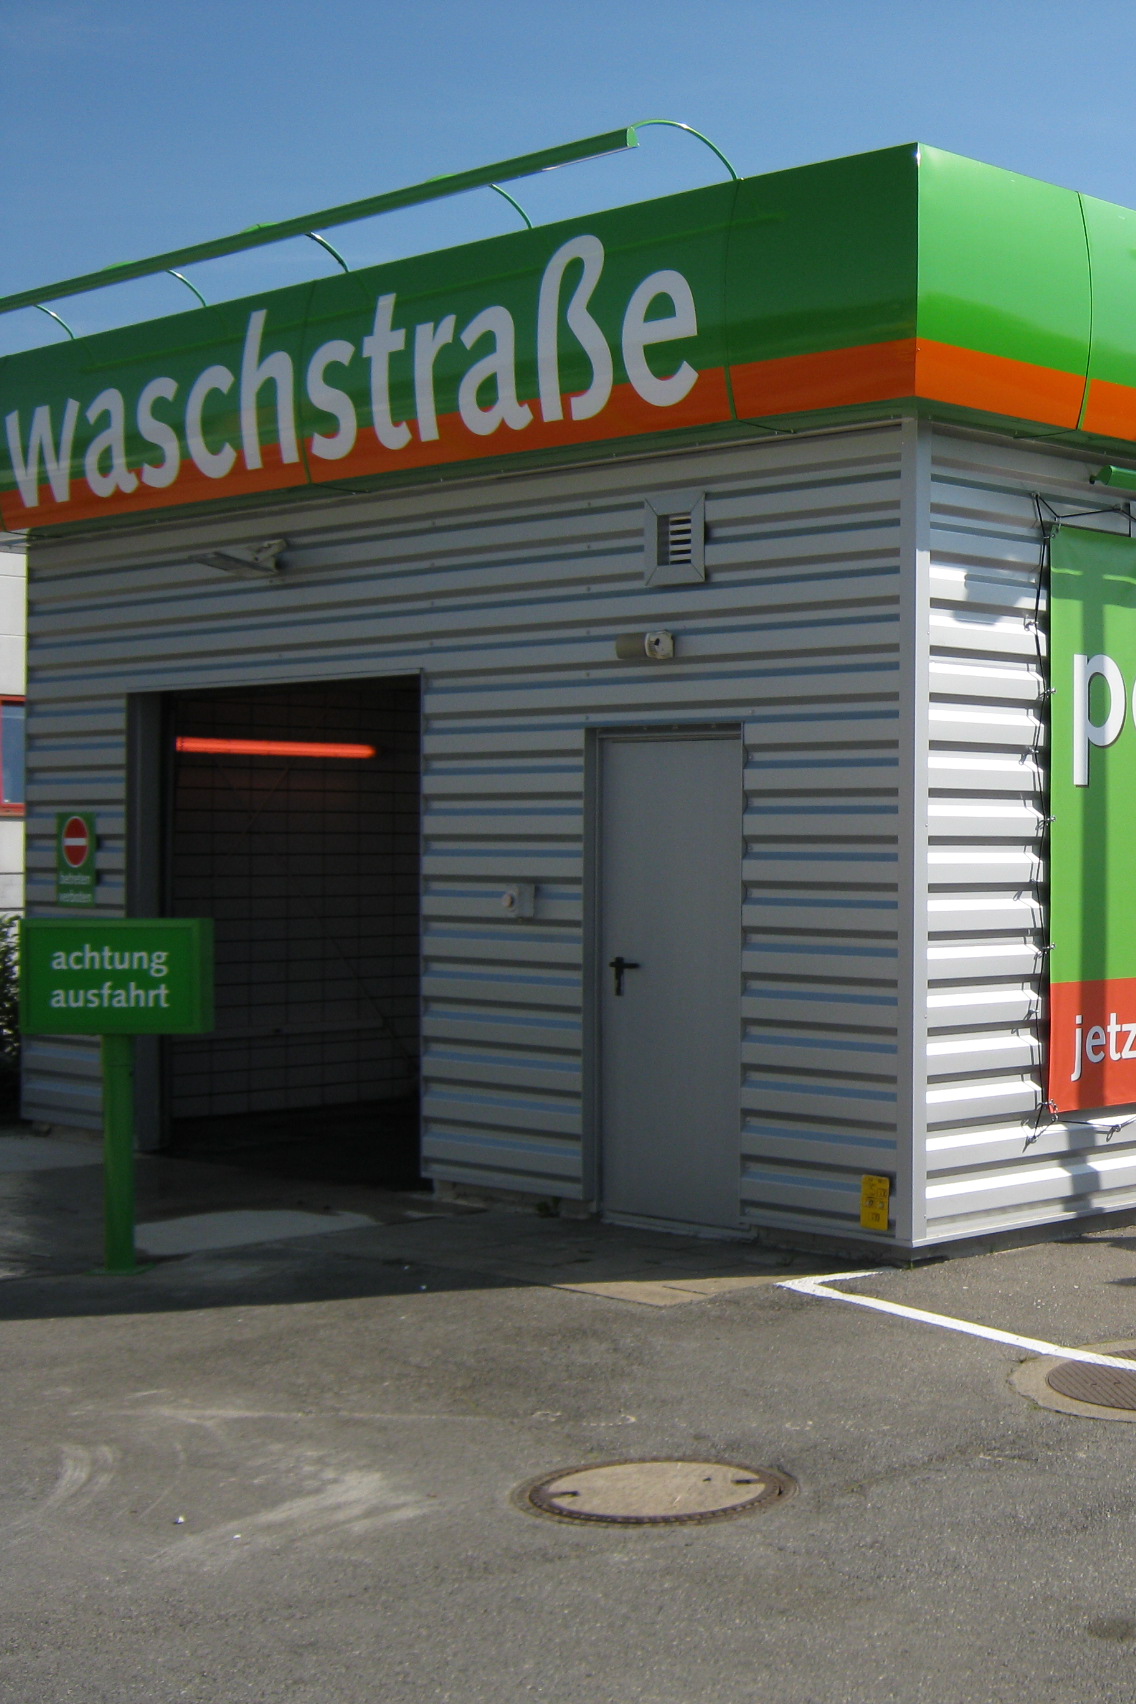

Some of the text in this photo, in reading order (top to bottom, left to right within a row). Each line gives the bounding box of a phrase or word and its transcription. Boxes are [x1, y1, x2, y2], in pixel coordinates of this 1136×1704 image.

[5, 234, 699, 508] waschstraße
[51, 944, 169, 977] achtung
[50, 981, 170, 1008] ausfahrt
